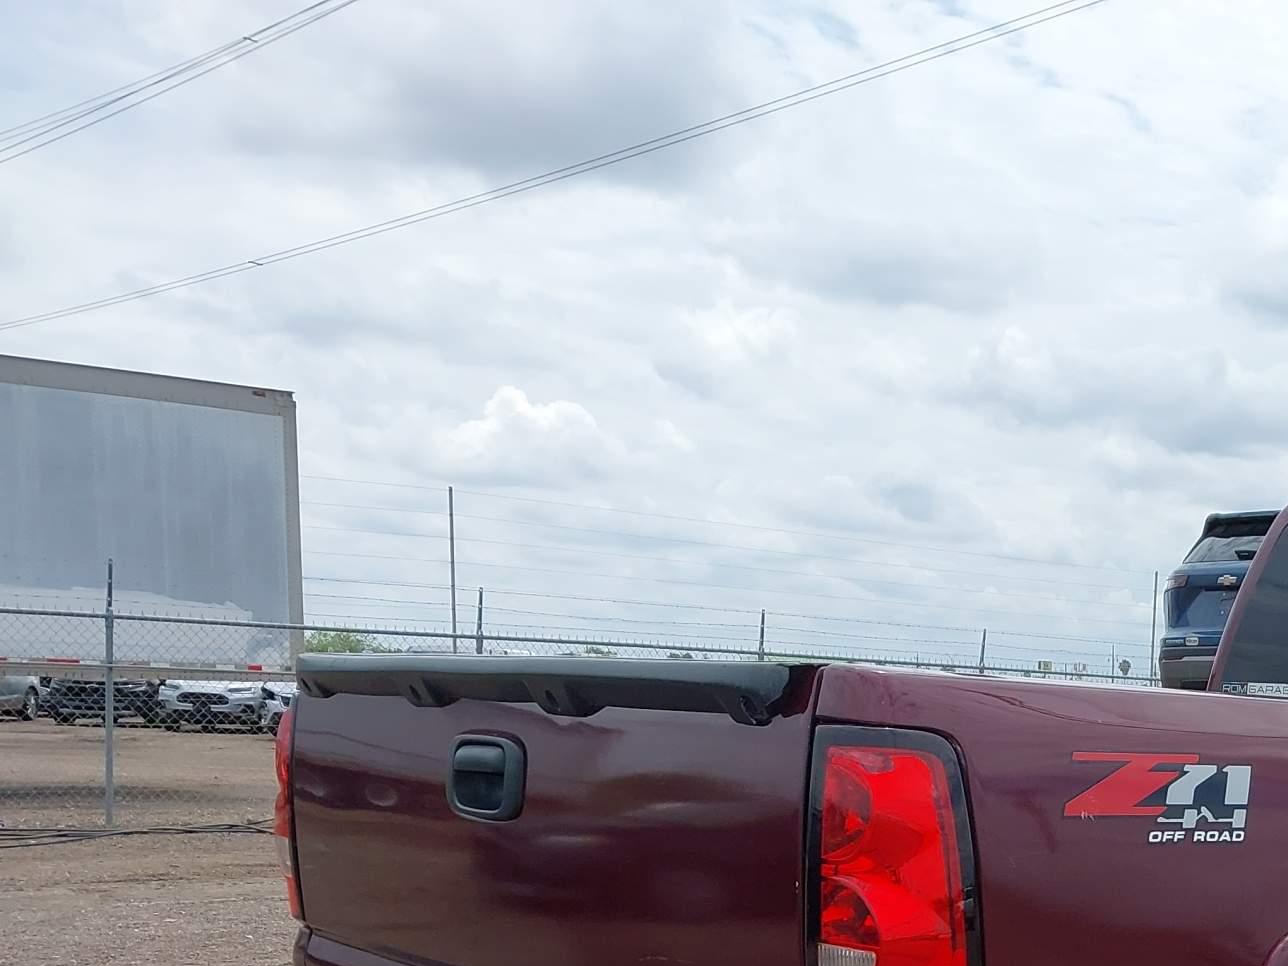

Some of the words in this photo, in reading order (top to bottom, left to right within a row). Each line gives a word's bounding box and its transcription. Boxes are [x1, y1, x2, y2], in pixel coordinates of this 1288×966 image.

[1064, 751, 1252, 816] Z71
[1148, 831, 1185, 843] OFF
[1192, 831, 1245, 843] ROAD
